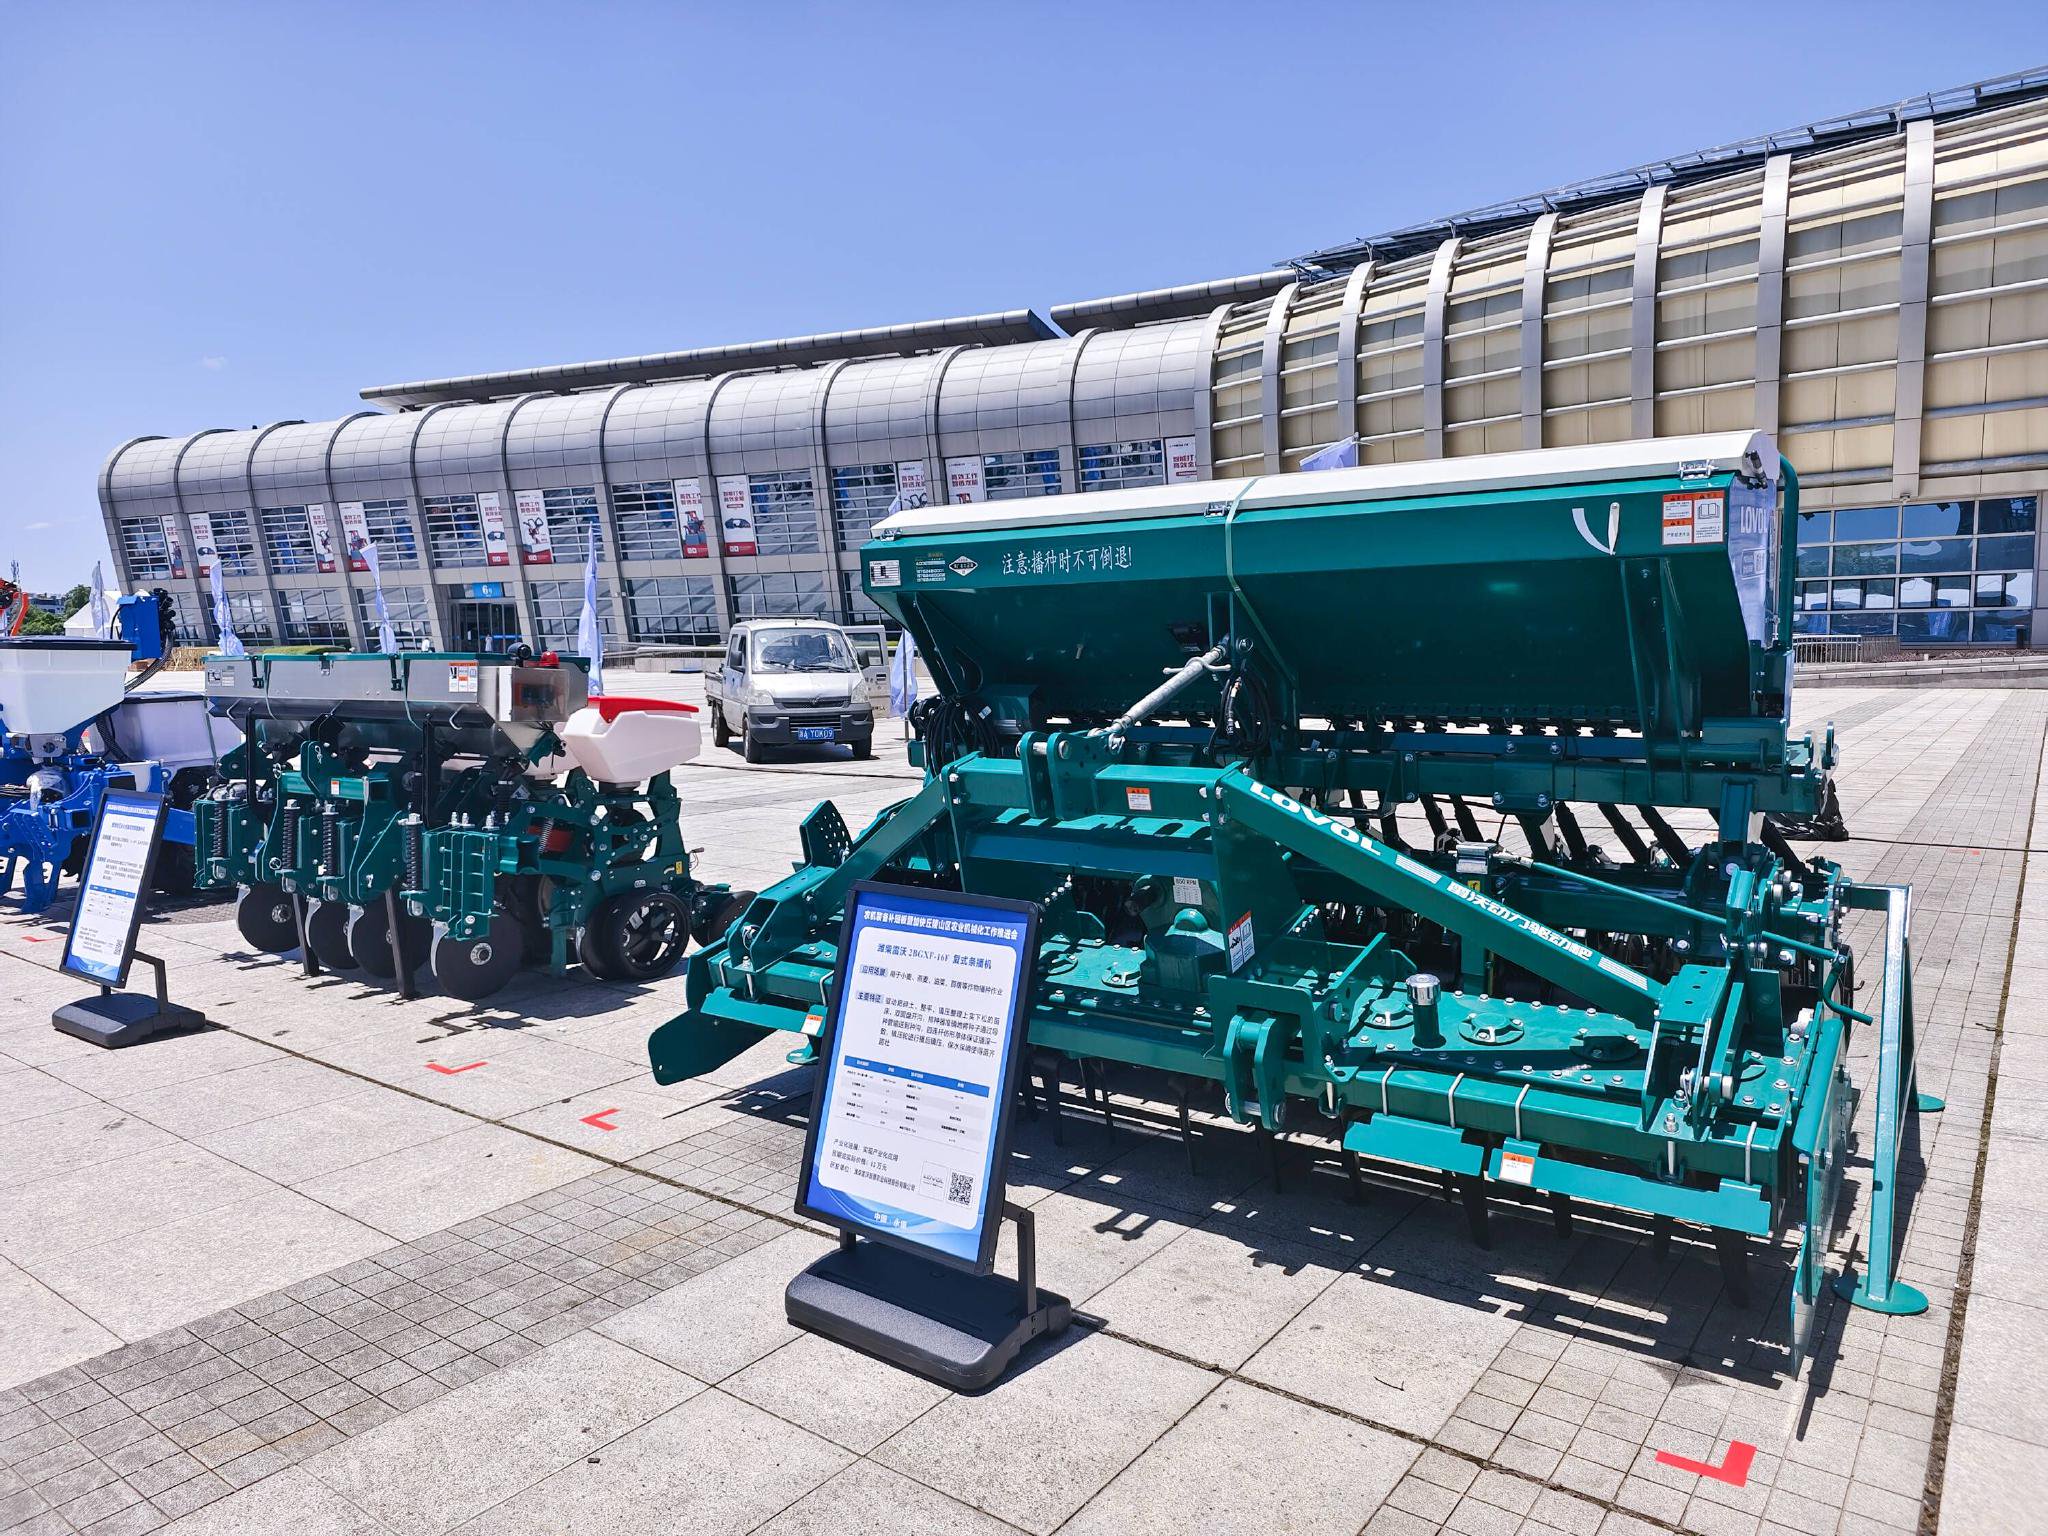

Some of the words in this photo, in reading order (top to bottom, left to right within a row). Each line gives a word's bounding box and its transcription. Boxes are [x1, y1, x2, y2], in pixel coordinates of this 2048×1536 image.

[1740, 506, 1768, 534] LOVOL
[1249, 781, 1382, 856] LOVOL
[1446, 881, 1594, 961] 雷沃动力驱动耙
